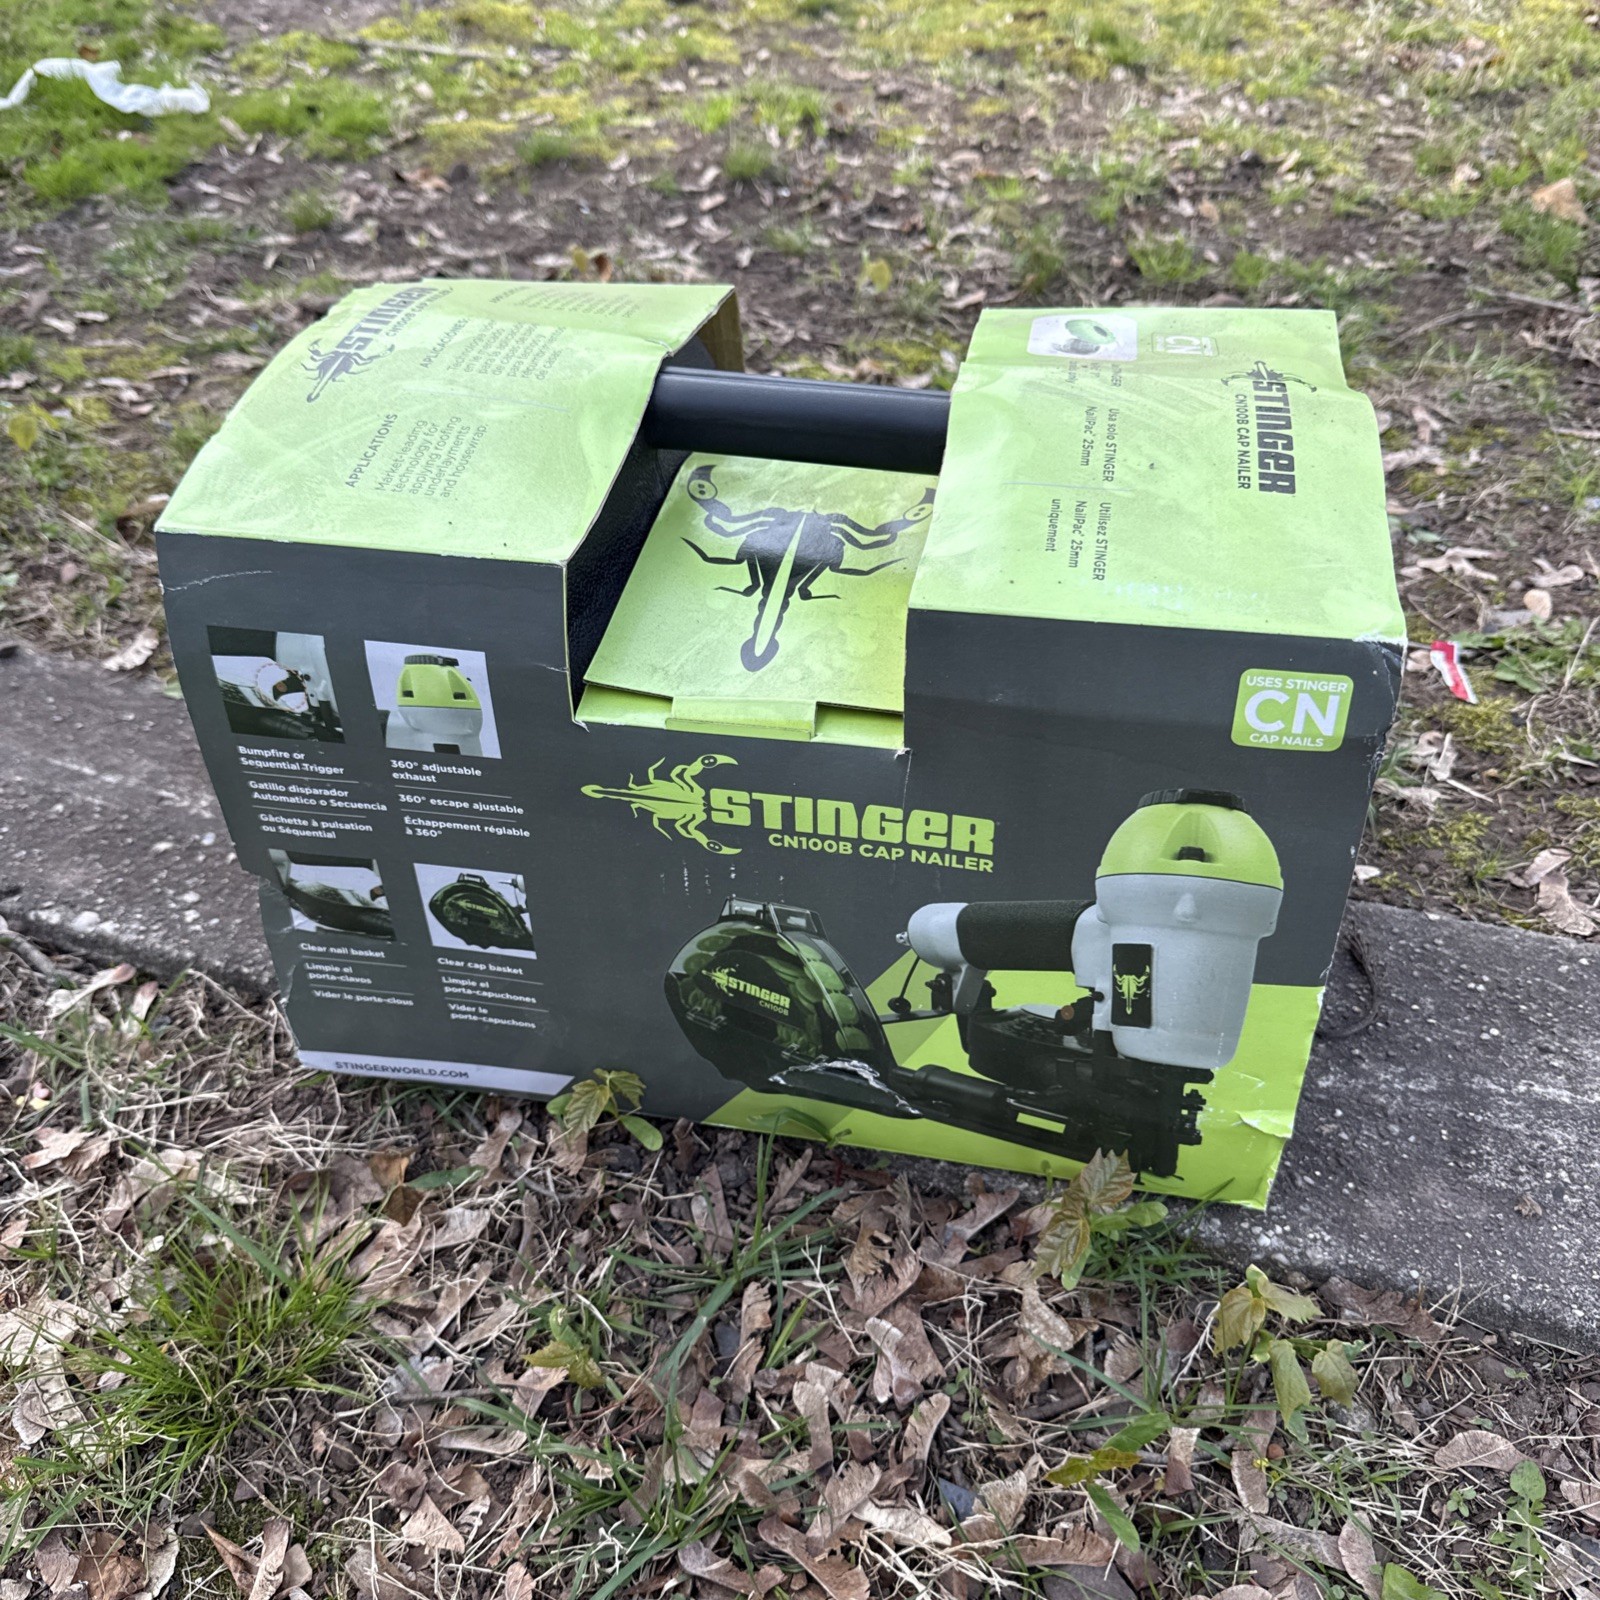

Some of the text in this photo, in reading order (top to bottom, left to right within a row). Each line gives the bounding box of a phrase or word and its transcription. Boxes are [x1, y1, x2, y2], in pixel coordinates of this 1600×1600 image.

[1102, 408, 1120, 482] Usa solo STINGER
[1235, 393, 1251, 490] CN100B CAP NAILER
[1252, 380, 1296, 495] STINGER
[345, 413, 398, 488] APPLICATIONS
[375, 419, 428, 491] Market-leading
[390, 422, 440, 493] technology for
[409, 416, 462, 495] applying roofing
[1080, 439, 1094, 467] 25mm
[424, 425, 471, 496] underlayments
[440, 479, 457, 498] and
[1044, 498, 1062, 552] uniquement
[1092, 501, 1112, 581] Utilisez STINGER
[1068, 539, 1083, 568] 25mm
[1246, 675, 1348, 693] USES STINGER
[1244, 689, 1340, 737] CN
[1249, 733, 1324, 747] CAP NAILS
[237, 745, 305, 760] Bumpfire or
[240, 757, 344, 775] Sequential Trigger
[390, 759, 482, 777] 360° adjustable
[392, 772, 437, 783] exhaust
[248, 780, 349, 797] Gatillo disparador
[253, 791, 317, 806] Automatico
[330, 799, 388, 811] Secuencia
[398, 794, 524, 815] 360° escape ajustable
[259, 813, 309, 826] Gâchette
[321, 821, 373, 832] pulsation
[403, 815, 530, 839] Échappement réglable
[709, 787, 995, 856] STINGER
[278, 825, 337, 839] Séquential
[767, 833, 994, 873] CN100B CAP NAILER
[300, 942, 385, 958] Clear nail basket
[305, 962, 353, 974] Limpie el
[437, 957, 524, 975] Clear cap basket
[441, 976, 490, 989] Limpie el
[343, 992, 353, 1000] le
[444, 985, 537, 1004] porta-capuchones
[728, 976, 791, 1009] STINGER
[447, 1003, 489, 1015] Vider le
[759, 1000, 789, 1016] CN100B
[450, 1012, 537, 1029] porte-capuchons
[335, 1061, 470, 1079] STINGERWORLD.COM
